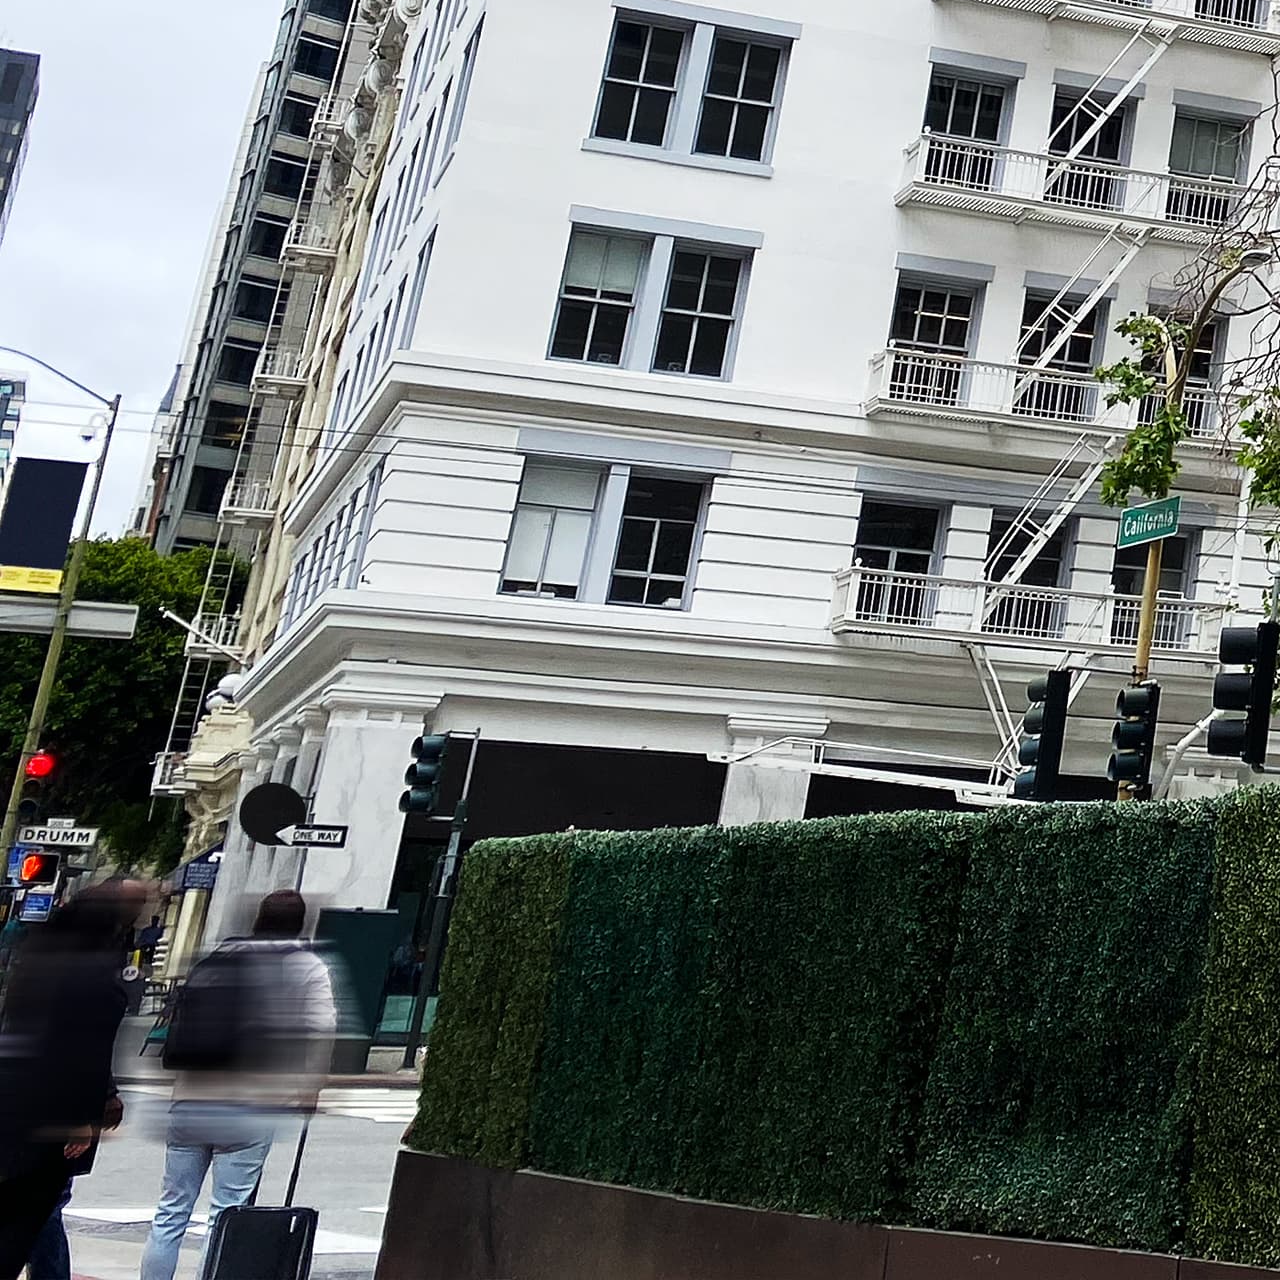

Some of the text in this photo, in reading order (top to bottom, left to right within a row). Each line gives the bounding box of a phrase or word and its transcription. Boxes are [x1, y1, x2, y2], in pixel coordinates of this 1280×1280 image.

[1124, 509, 1174, 537] California
[24, 829, 91, 843] DRUMM
[293, 830, 340, 841] ONE WAY
